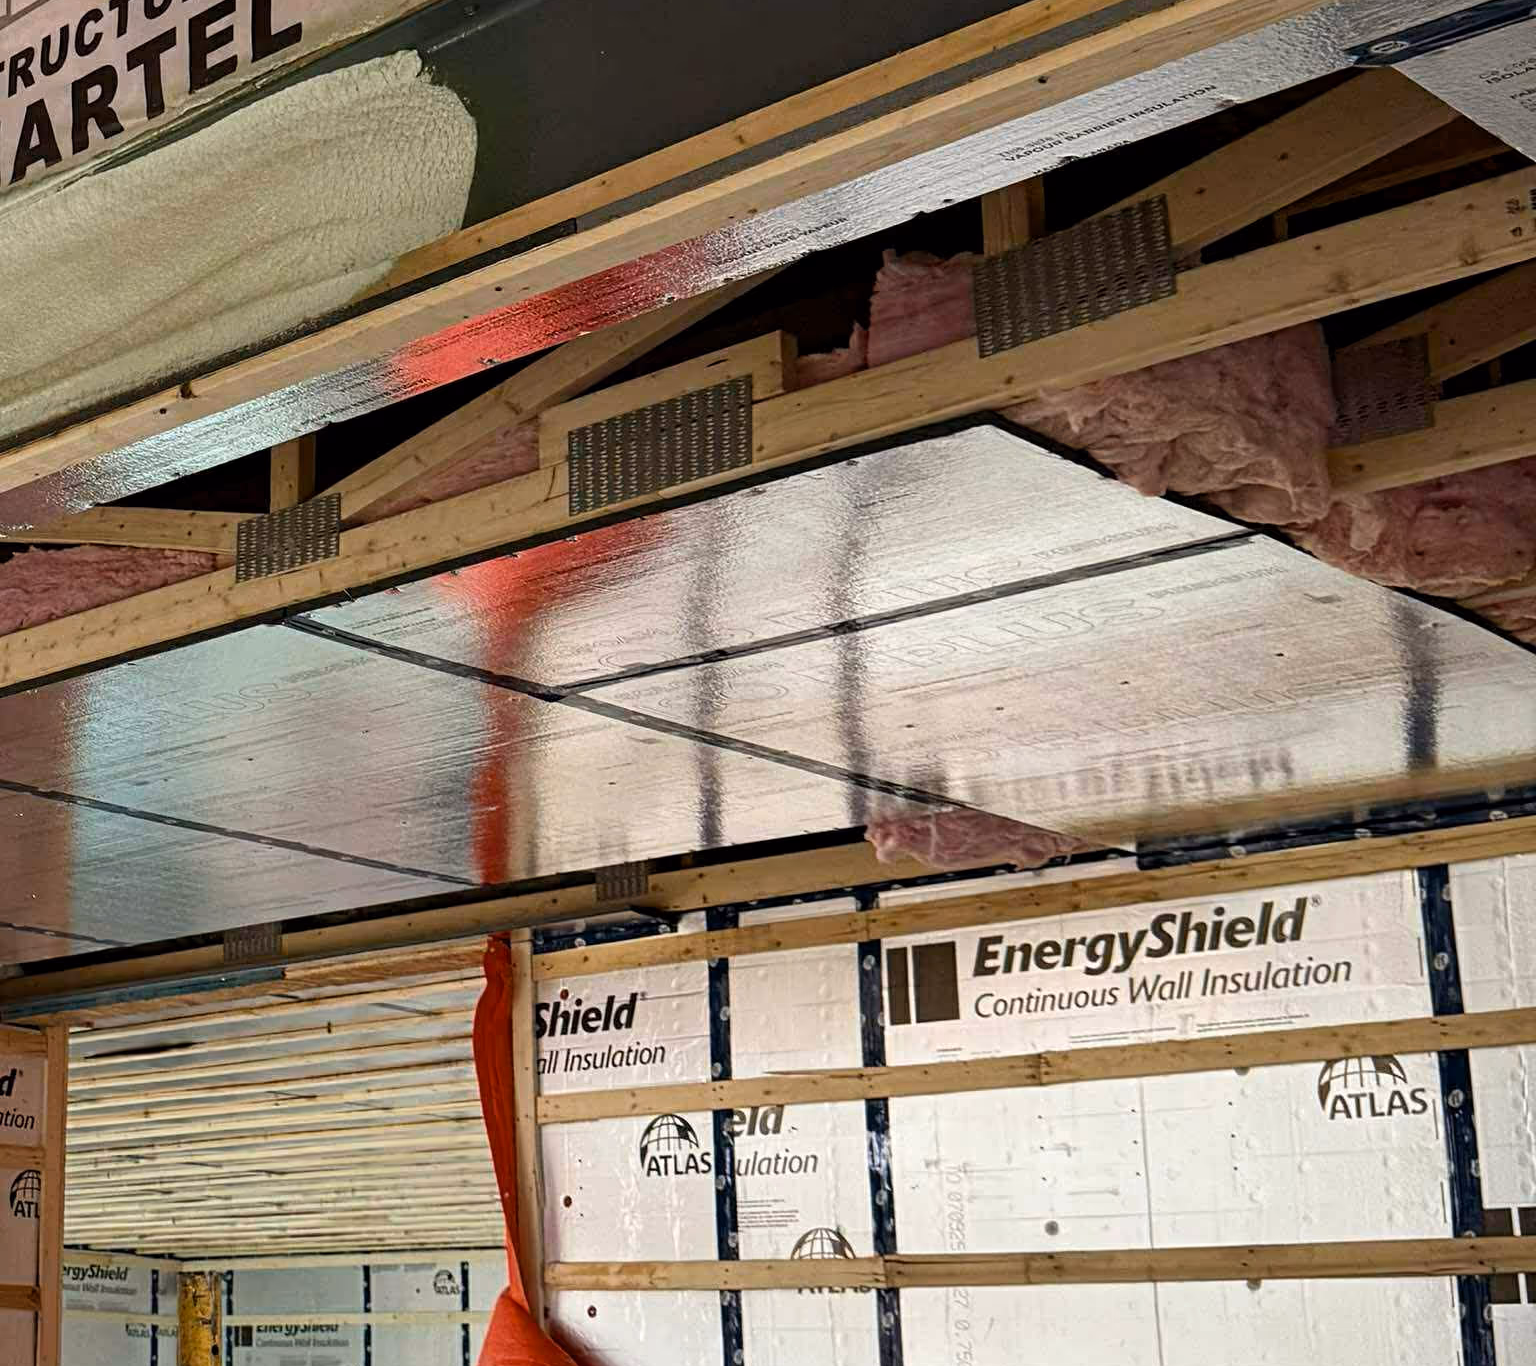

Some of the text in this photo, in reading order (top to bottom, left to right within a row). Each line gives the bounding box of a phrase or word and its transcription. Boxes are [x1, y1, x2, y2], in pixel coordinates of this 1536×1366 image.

[1129, 84, 1218, 121] INSULATION
[973, 955, 1352, 1019] Continuous Wall Insulation
[563, 1042, 666, 1074] Insulation
[1328, 1086, 1429, 1121] ATLAS
[646, 1151, 712, 1177] ATLAS
